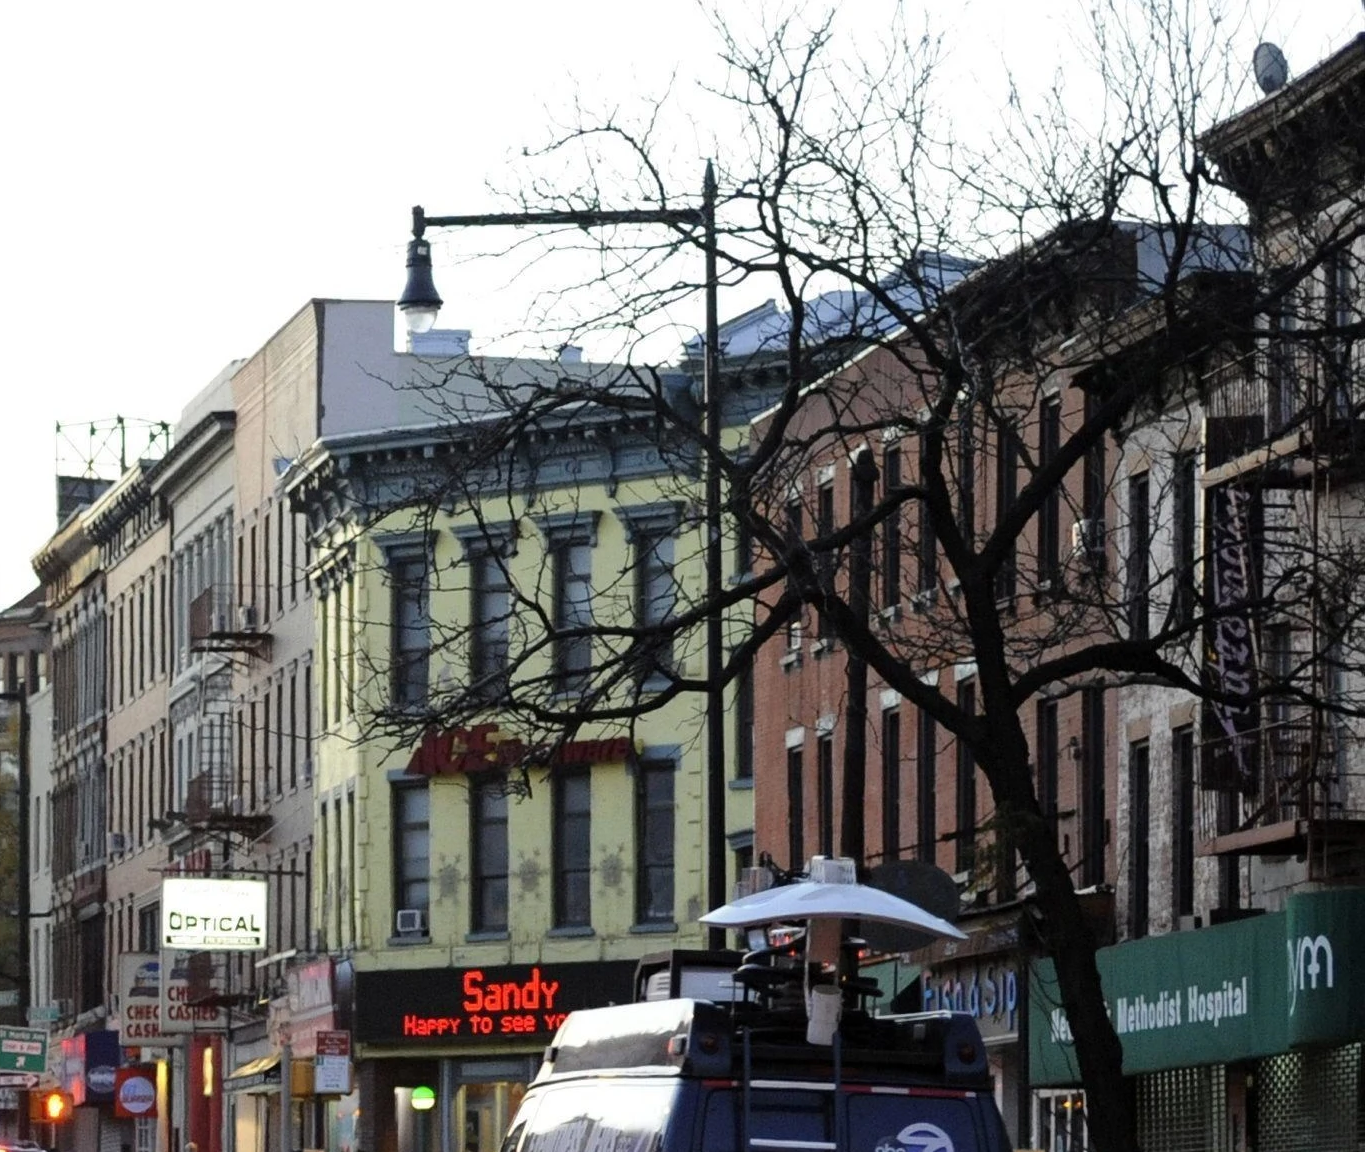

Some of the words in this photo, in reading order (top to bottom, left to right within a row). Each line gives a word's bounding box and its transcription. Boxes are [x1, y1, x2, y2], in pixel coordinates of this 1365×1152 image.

[169, 911, 261, 932] OPTICAL
[463, 967, 560, 1012] Sandy
[127, 1005, 159, 1020] CHEC
[1117, 990, 1182, 1035] Methodist
[1187, 976, 1248, 1028] Hospital
[127, 1023, 161, 1038] CASH
[404, 1014, 461, 1036] Happy
[500, 1015, 536, 1033] see
